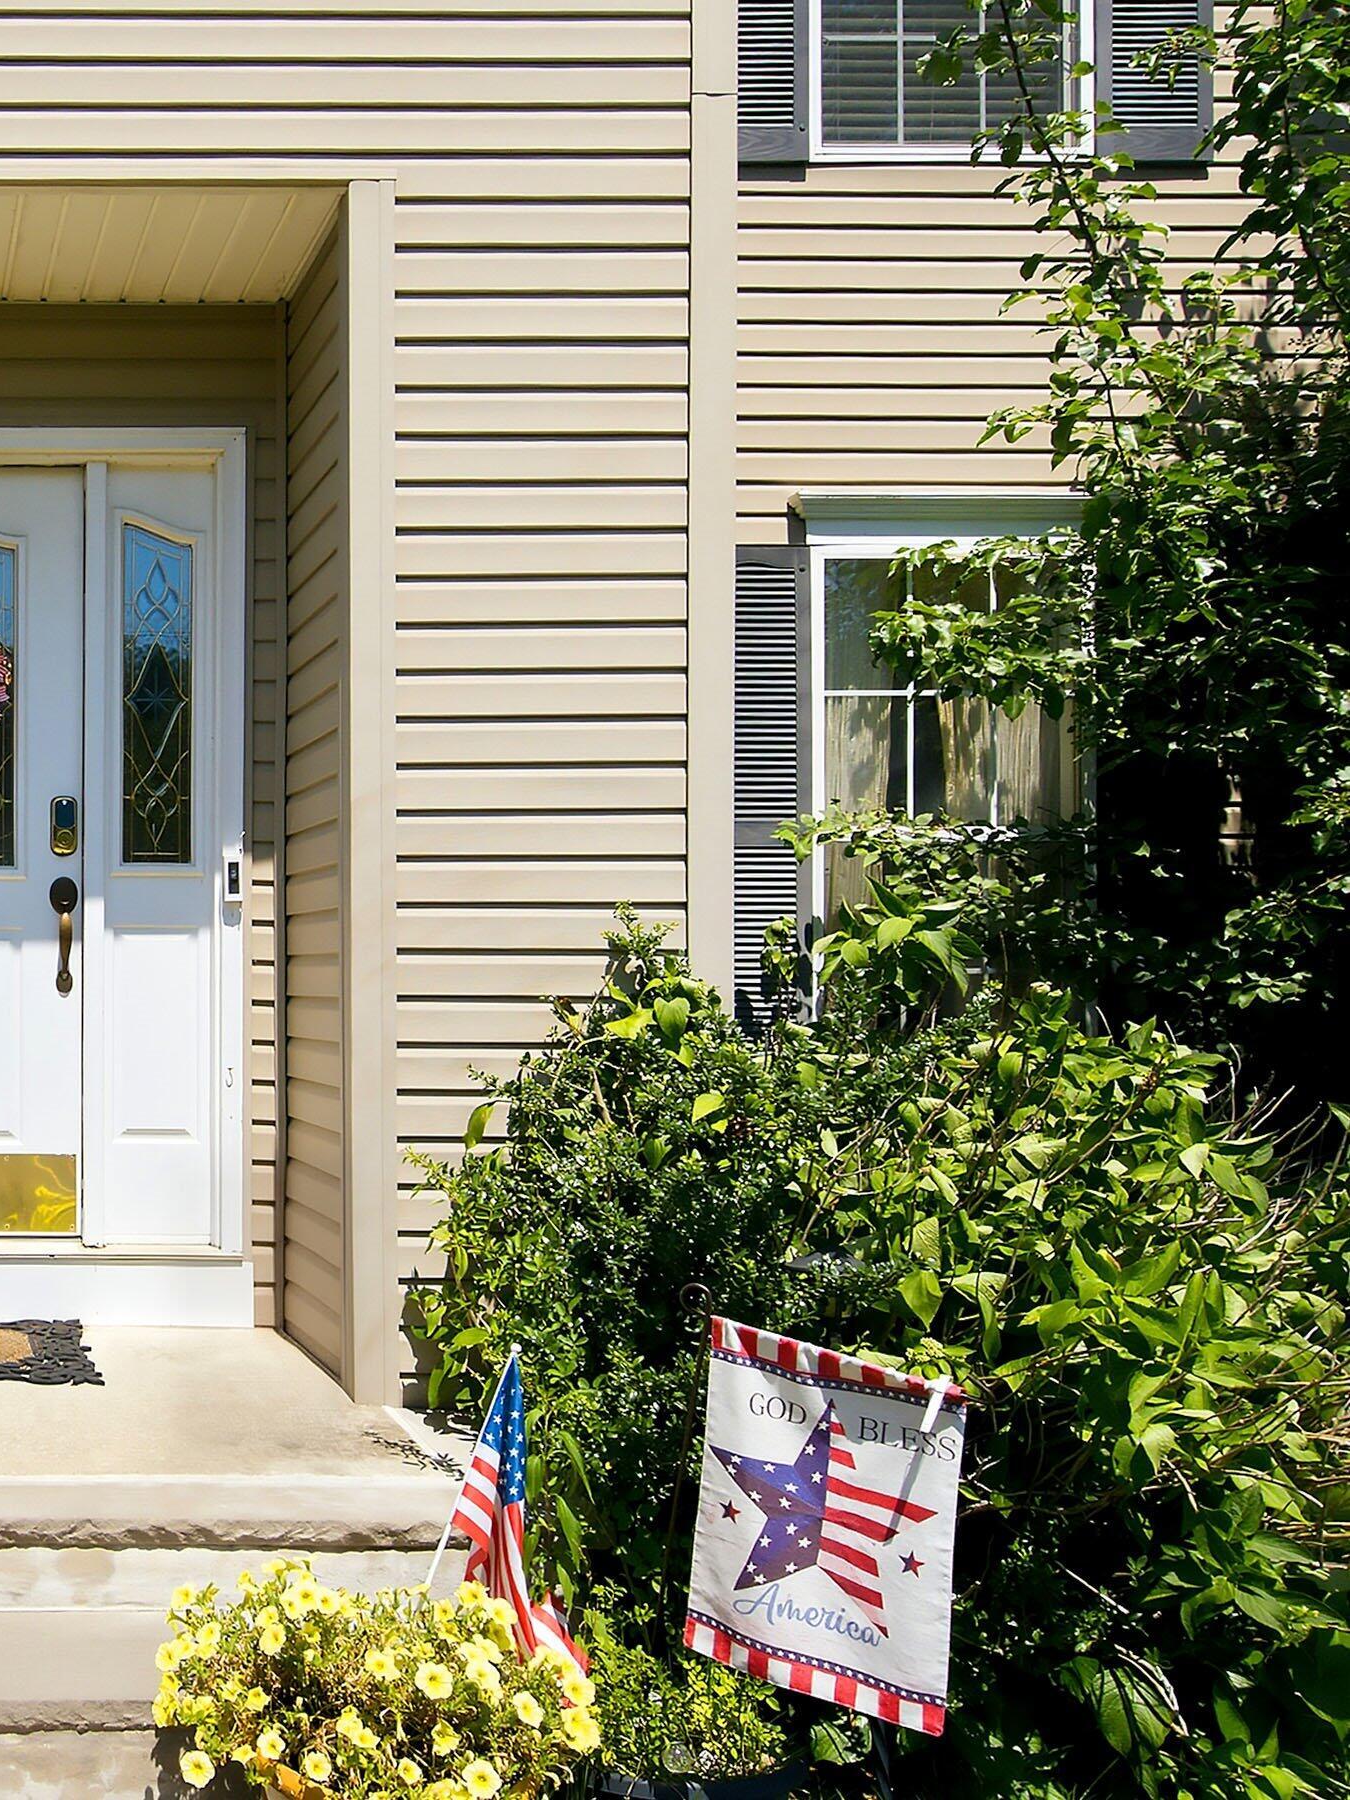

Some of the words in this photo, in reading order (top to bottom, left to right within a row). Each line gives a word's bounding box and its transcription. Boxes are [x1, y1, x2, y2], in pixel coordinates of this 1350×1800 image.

[749, 1392, 807, 1425] GOD
[858, 1416, 956, 1462] BLESS
[734, 1584, 882, 1648] America
